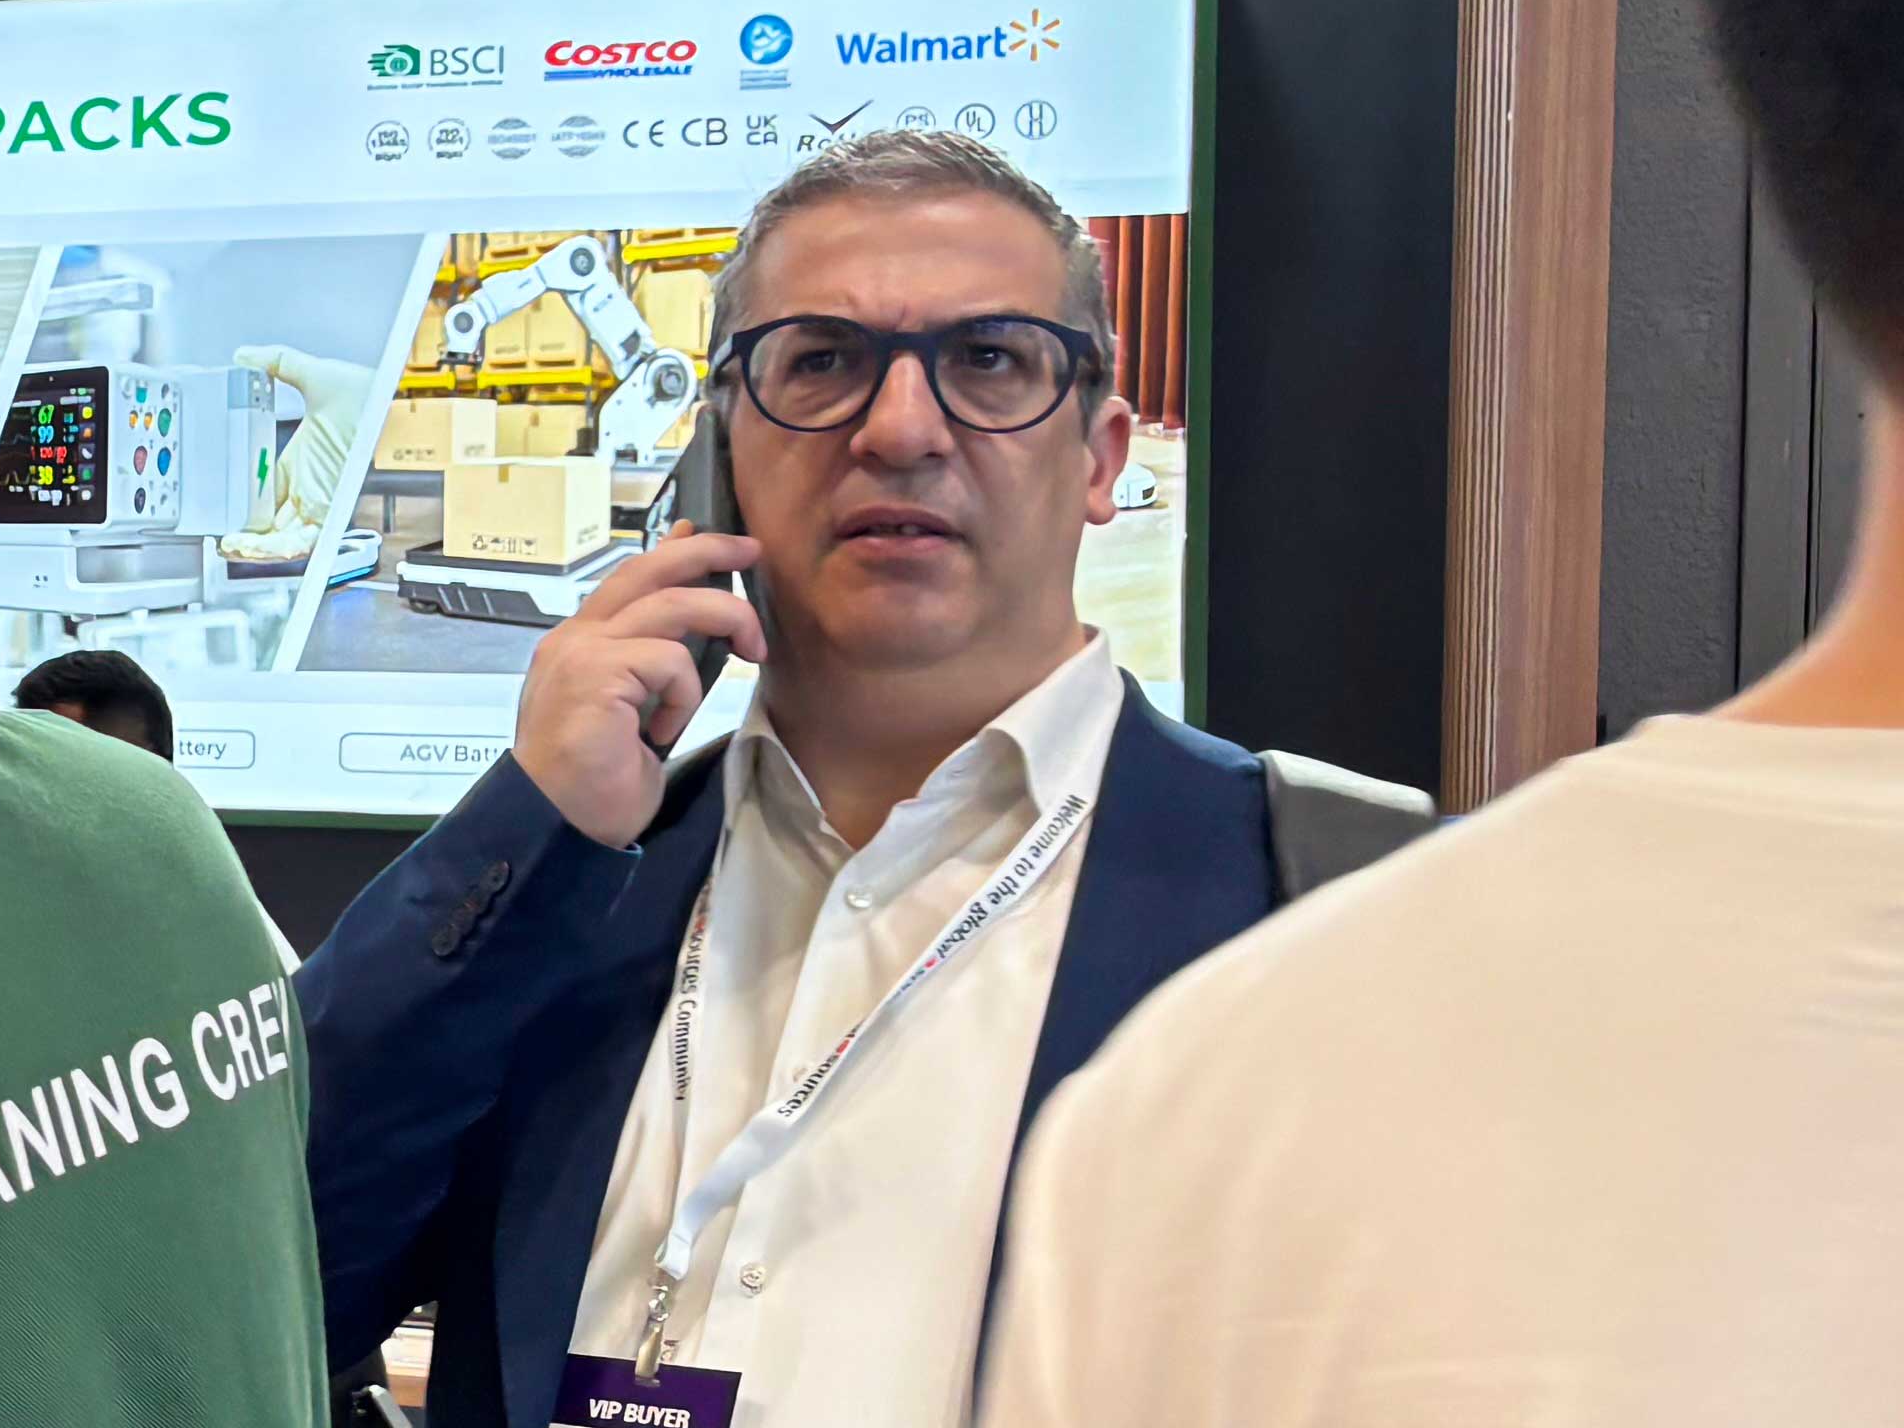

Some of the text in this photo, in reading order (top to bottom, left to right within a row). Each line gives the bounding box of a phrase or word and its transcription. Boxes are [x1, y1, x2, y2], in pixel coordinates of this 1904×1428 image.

[544, 39, 697, 66] COSTCO
[835, 25, 1008, 66] Walmart
[429, 44, 505, 77] BSCI
[681, 117, 728, 147] CB
[178, 739, 227, 760] ttery
[399, 743, 449, 762] AGV
[1029, 793, 1089, 859] Welcome
[1012, 856, 1036, 877] to
[986, 874, 1020, 905] the
[589, 1398, 623, 1421] VIP
